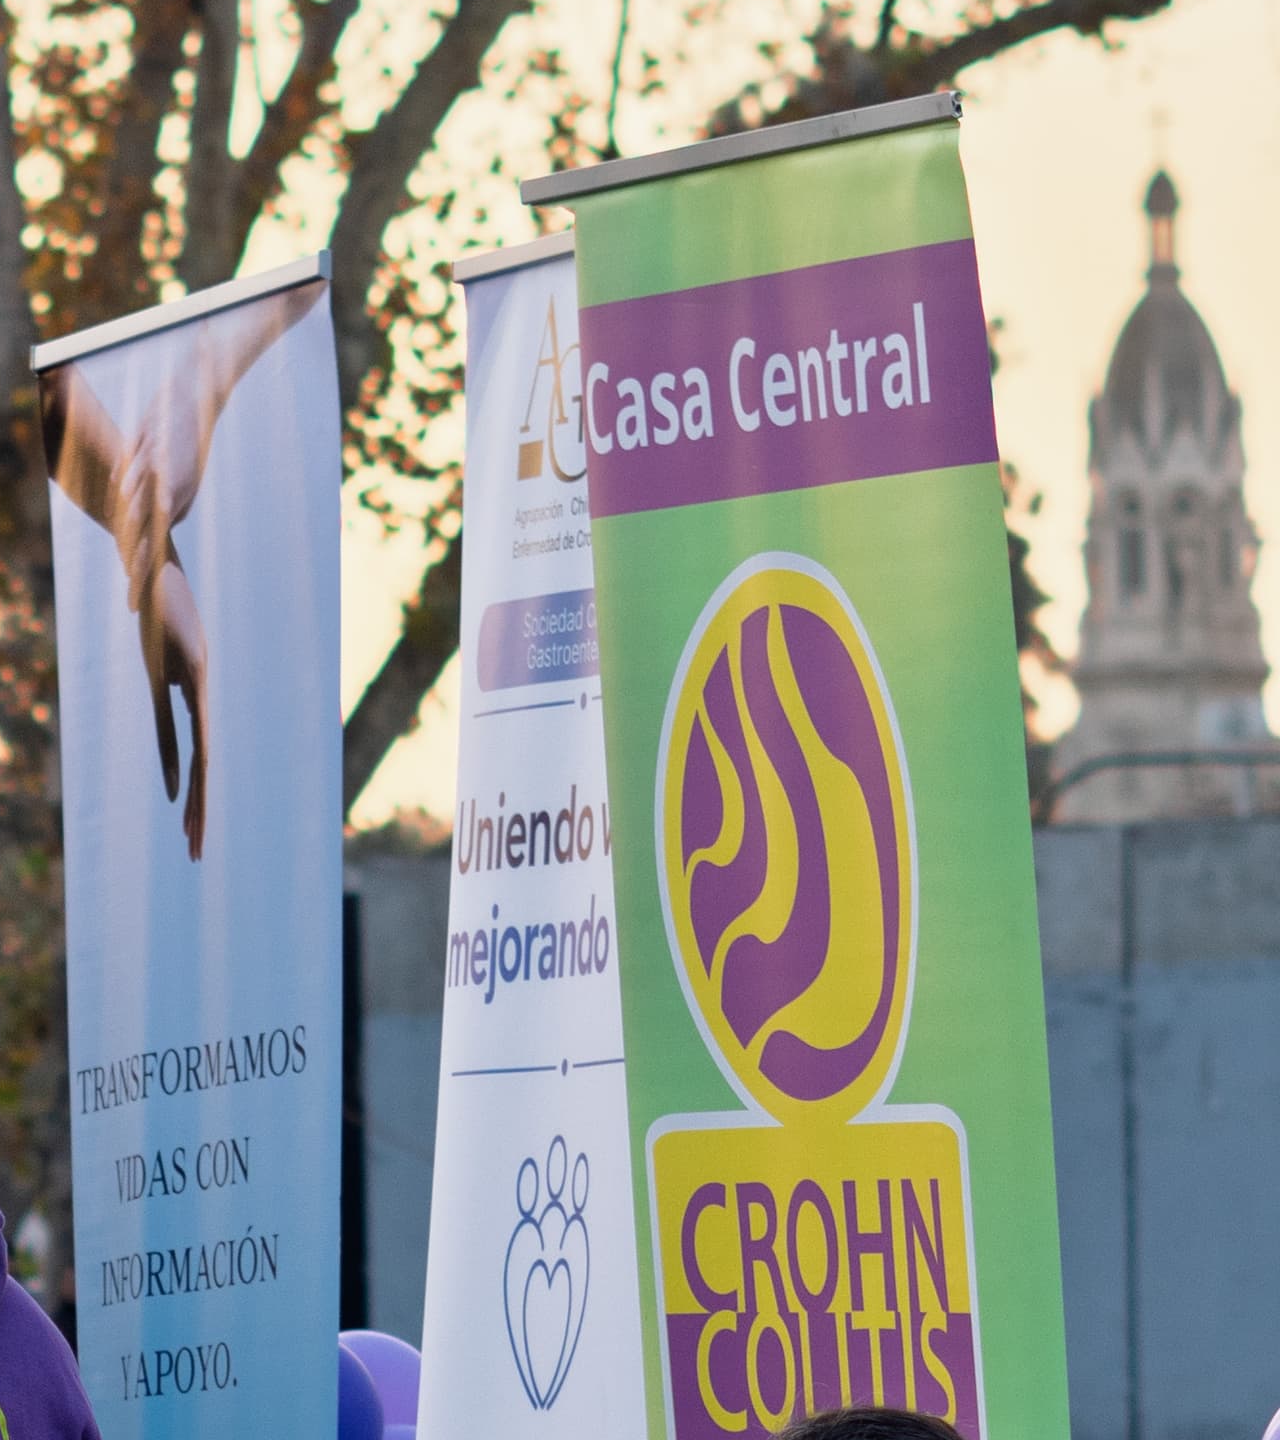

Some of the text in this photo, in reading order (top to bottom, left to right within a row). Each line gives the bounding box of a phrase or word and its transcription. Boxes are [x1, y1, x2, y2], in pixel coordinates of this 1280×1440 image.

[587, 301, 931, 455] Casa Central
[513, 532, 560, 559] Enfermedad
[563, 529, 575, 550] de
[523, 604, 584, 638] Sociedad
[458, 784, 594, 875] Uniendo
[448, 894, 610, 1004] mejorando
[77, 1024, 308, 1115] TRANSFORMAMOS
[115, 1136, 250, 1205] VIDAS CON
[101, 1225, 279, 1307] INFORMACIÓN
[681, 1178, 949, 1313] CROHN
[121, 1342, 238, 1401] Y APOYO.
